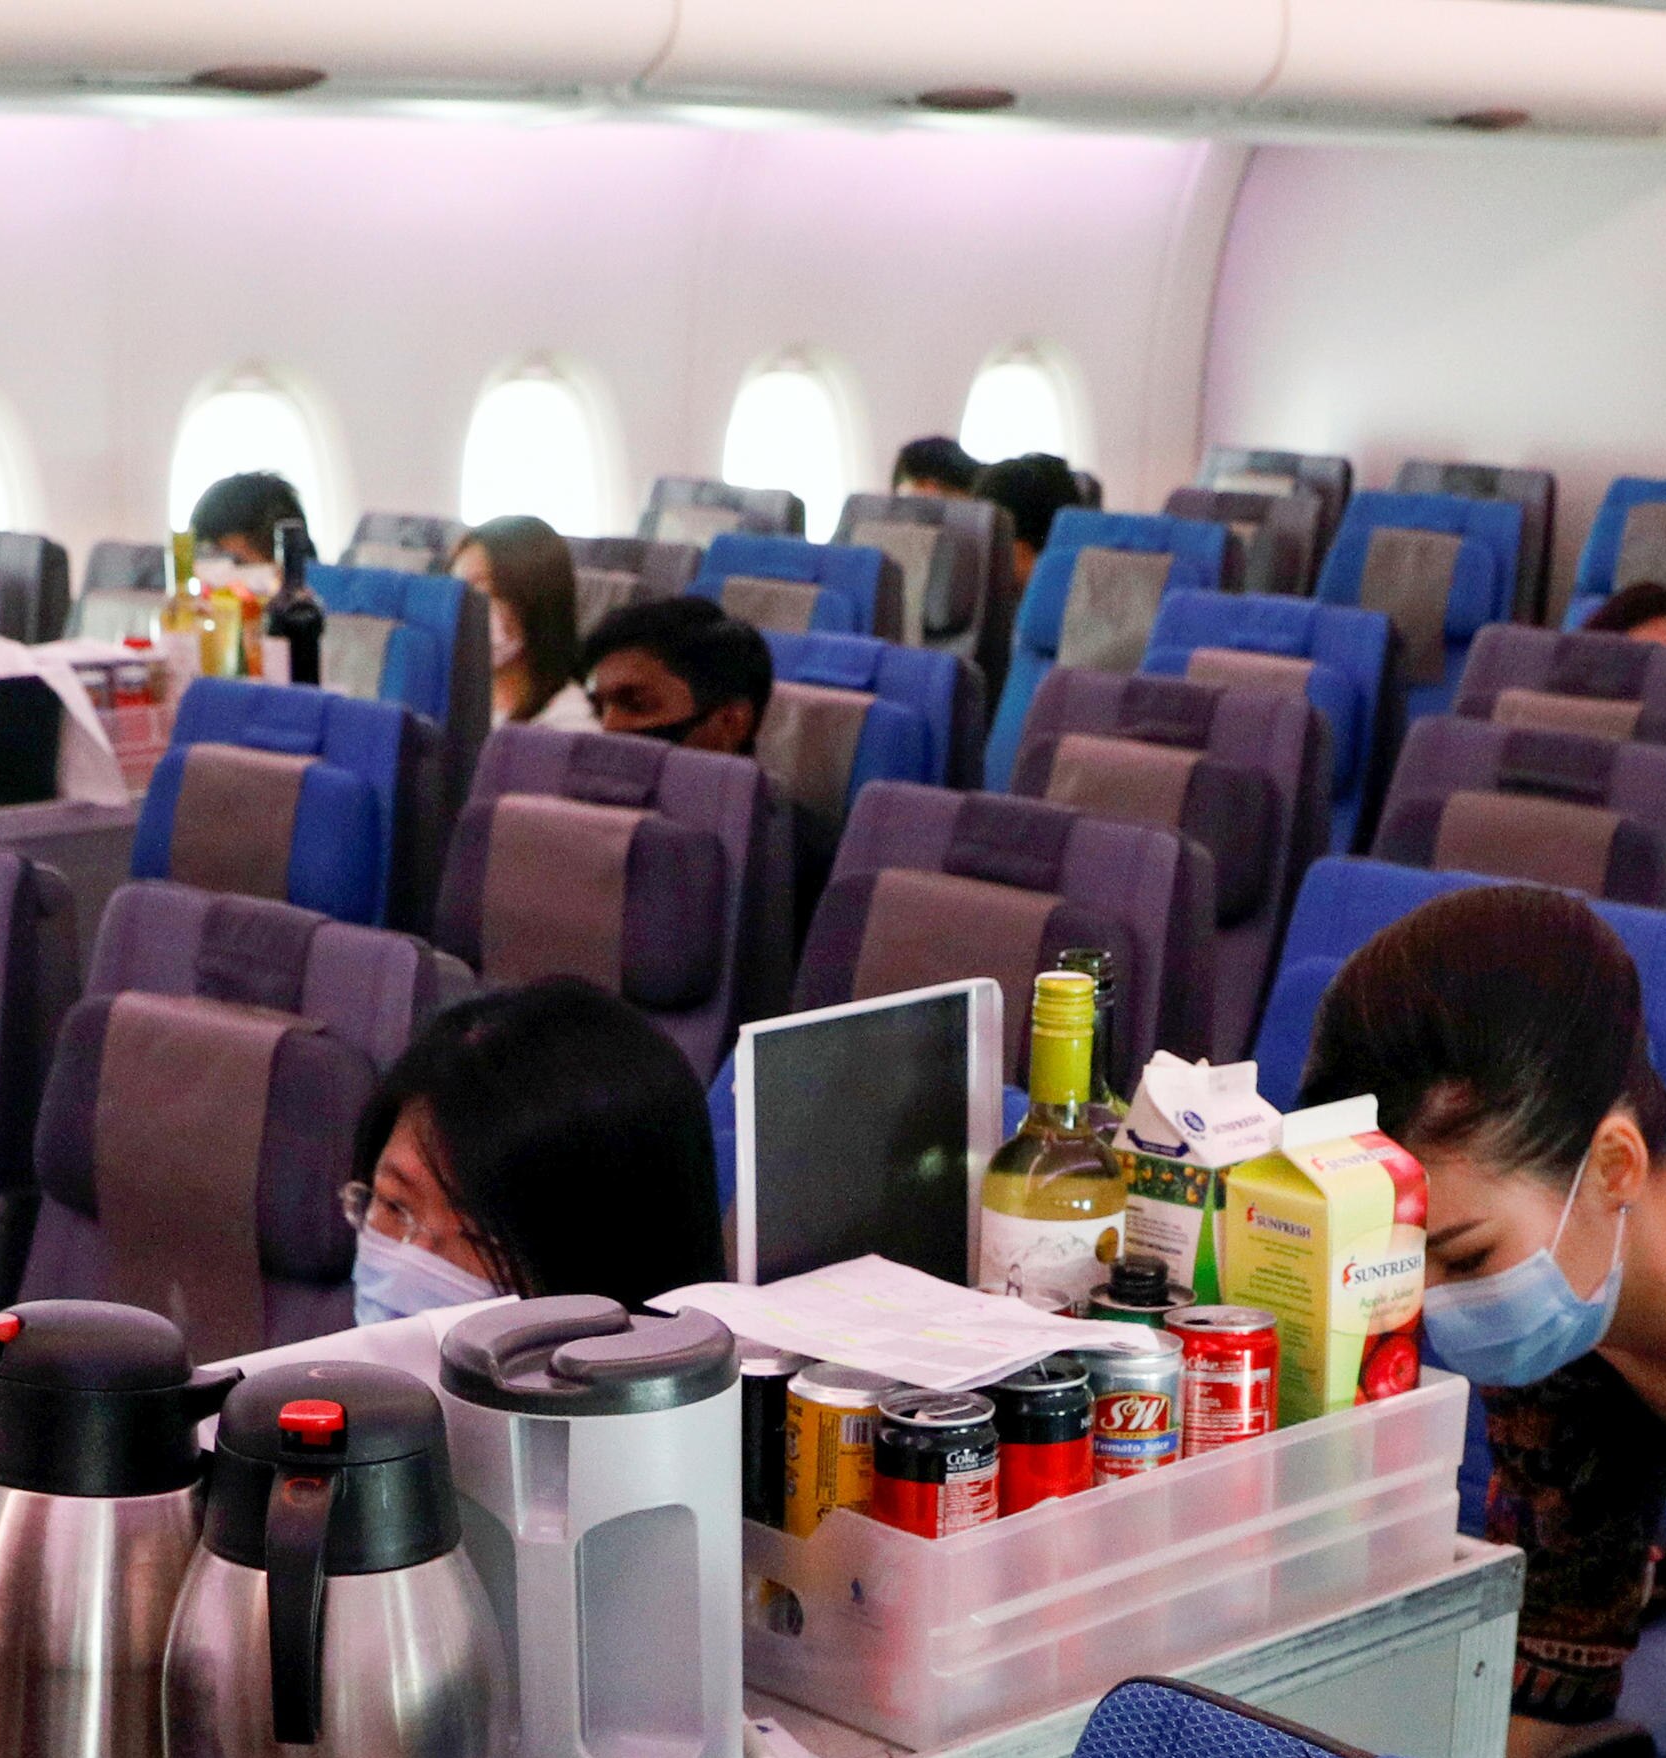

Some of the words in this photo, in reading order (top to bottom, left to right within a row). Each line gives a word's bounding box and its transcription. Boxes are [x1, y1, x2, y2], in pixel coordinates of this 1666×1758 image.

[1326, 1146, 1395, 1168] SUNFRESH
[1256, 1214, 1311, 1239] SUNFRESH
[1354, 1254, 1422, 1284] SUNFRESH
[946, 1448, 979, 1466] Coke
[1094, 1440, 1141, 1453] Tomato
[1144, 1440, 1170, 1451] Juice
